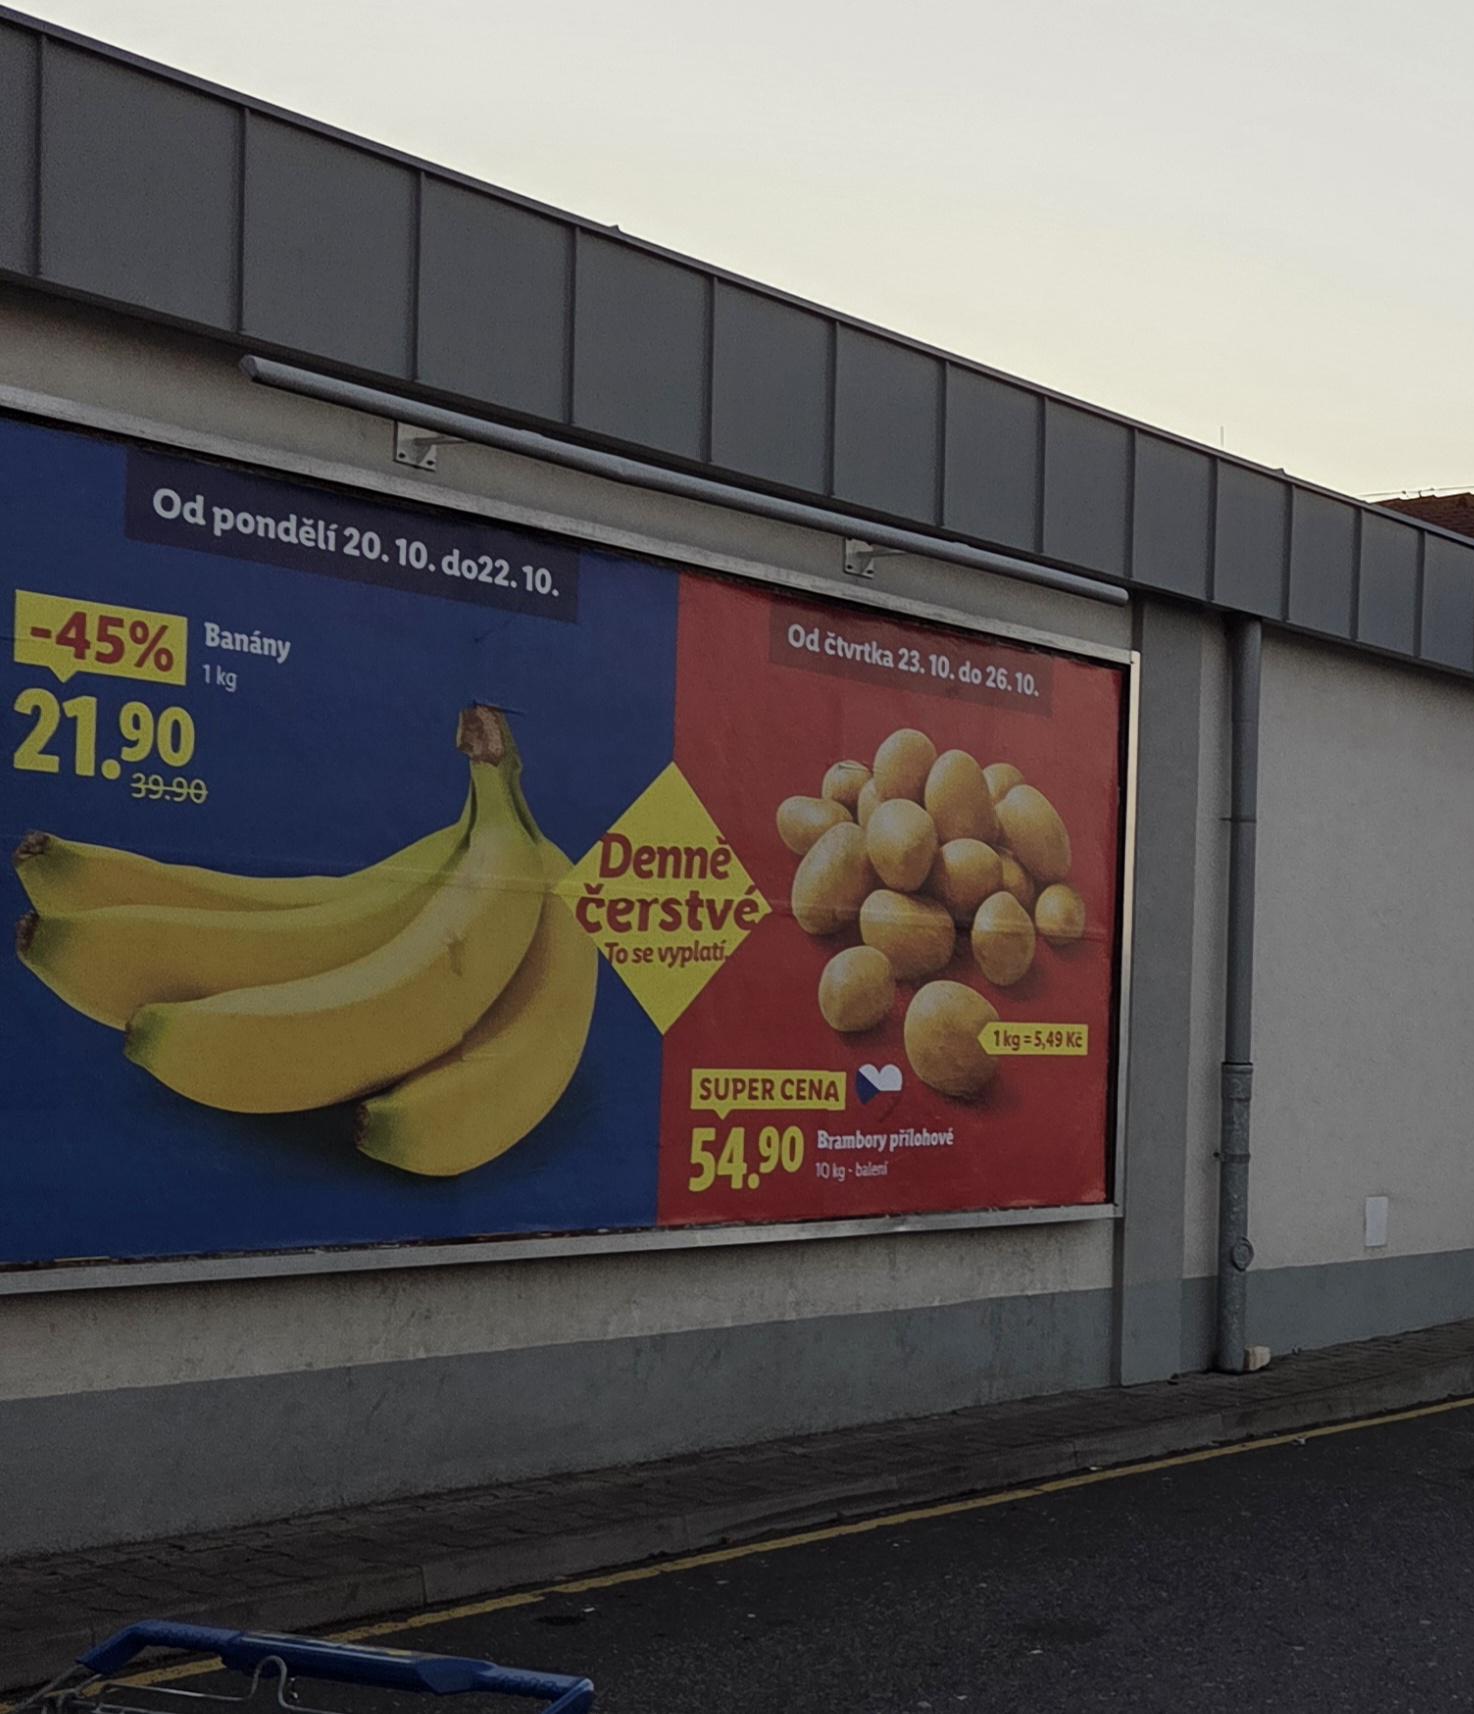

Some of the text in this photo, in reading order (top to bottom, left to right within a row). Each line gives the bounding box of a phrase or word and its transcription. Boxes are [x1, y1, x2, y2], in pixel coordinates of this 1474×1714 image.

[152, 488, 206, 525] Od
[213, 506, 338, 552] pondělí
[343, 527, 390, 562] 20.
[395, 538, 436, 572] 10.
[522, 565, 560, 597] 10.
[30, 611, 174, 673] -45%
[204, 622, 291, 664] Banány
[788, 624, 1040, 697] Od čtvrtka 23. 10. do 26. 10.
[203, 664, 237, 692] 1 kg
[13, 687, 195, 780] 21.90
[131, 772, 208, 804] 39.90
[599, 833, 733, 880] Denně
[576, 883, 760, 934] čerstvé
[604, 942, 628, 964] To
[632, 946, 654, 963] se
[993, 1030, 1082, 1051] 1 kg = 5,49 Kč
[699, 1077, 840, 1102] SUPER CENA
[688, 1125, 804, 1192] 54.90
[817, 1128, 954, 1152] Brambory přílohové
[816, 1162, 830, 1179] 10
[832, 1163, 845, 1181] kg
[856, 1160, 888, 1177] balení
